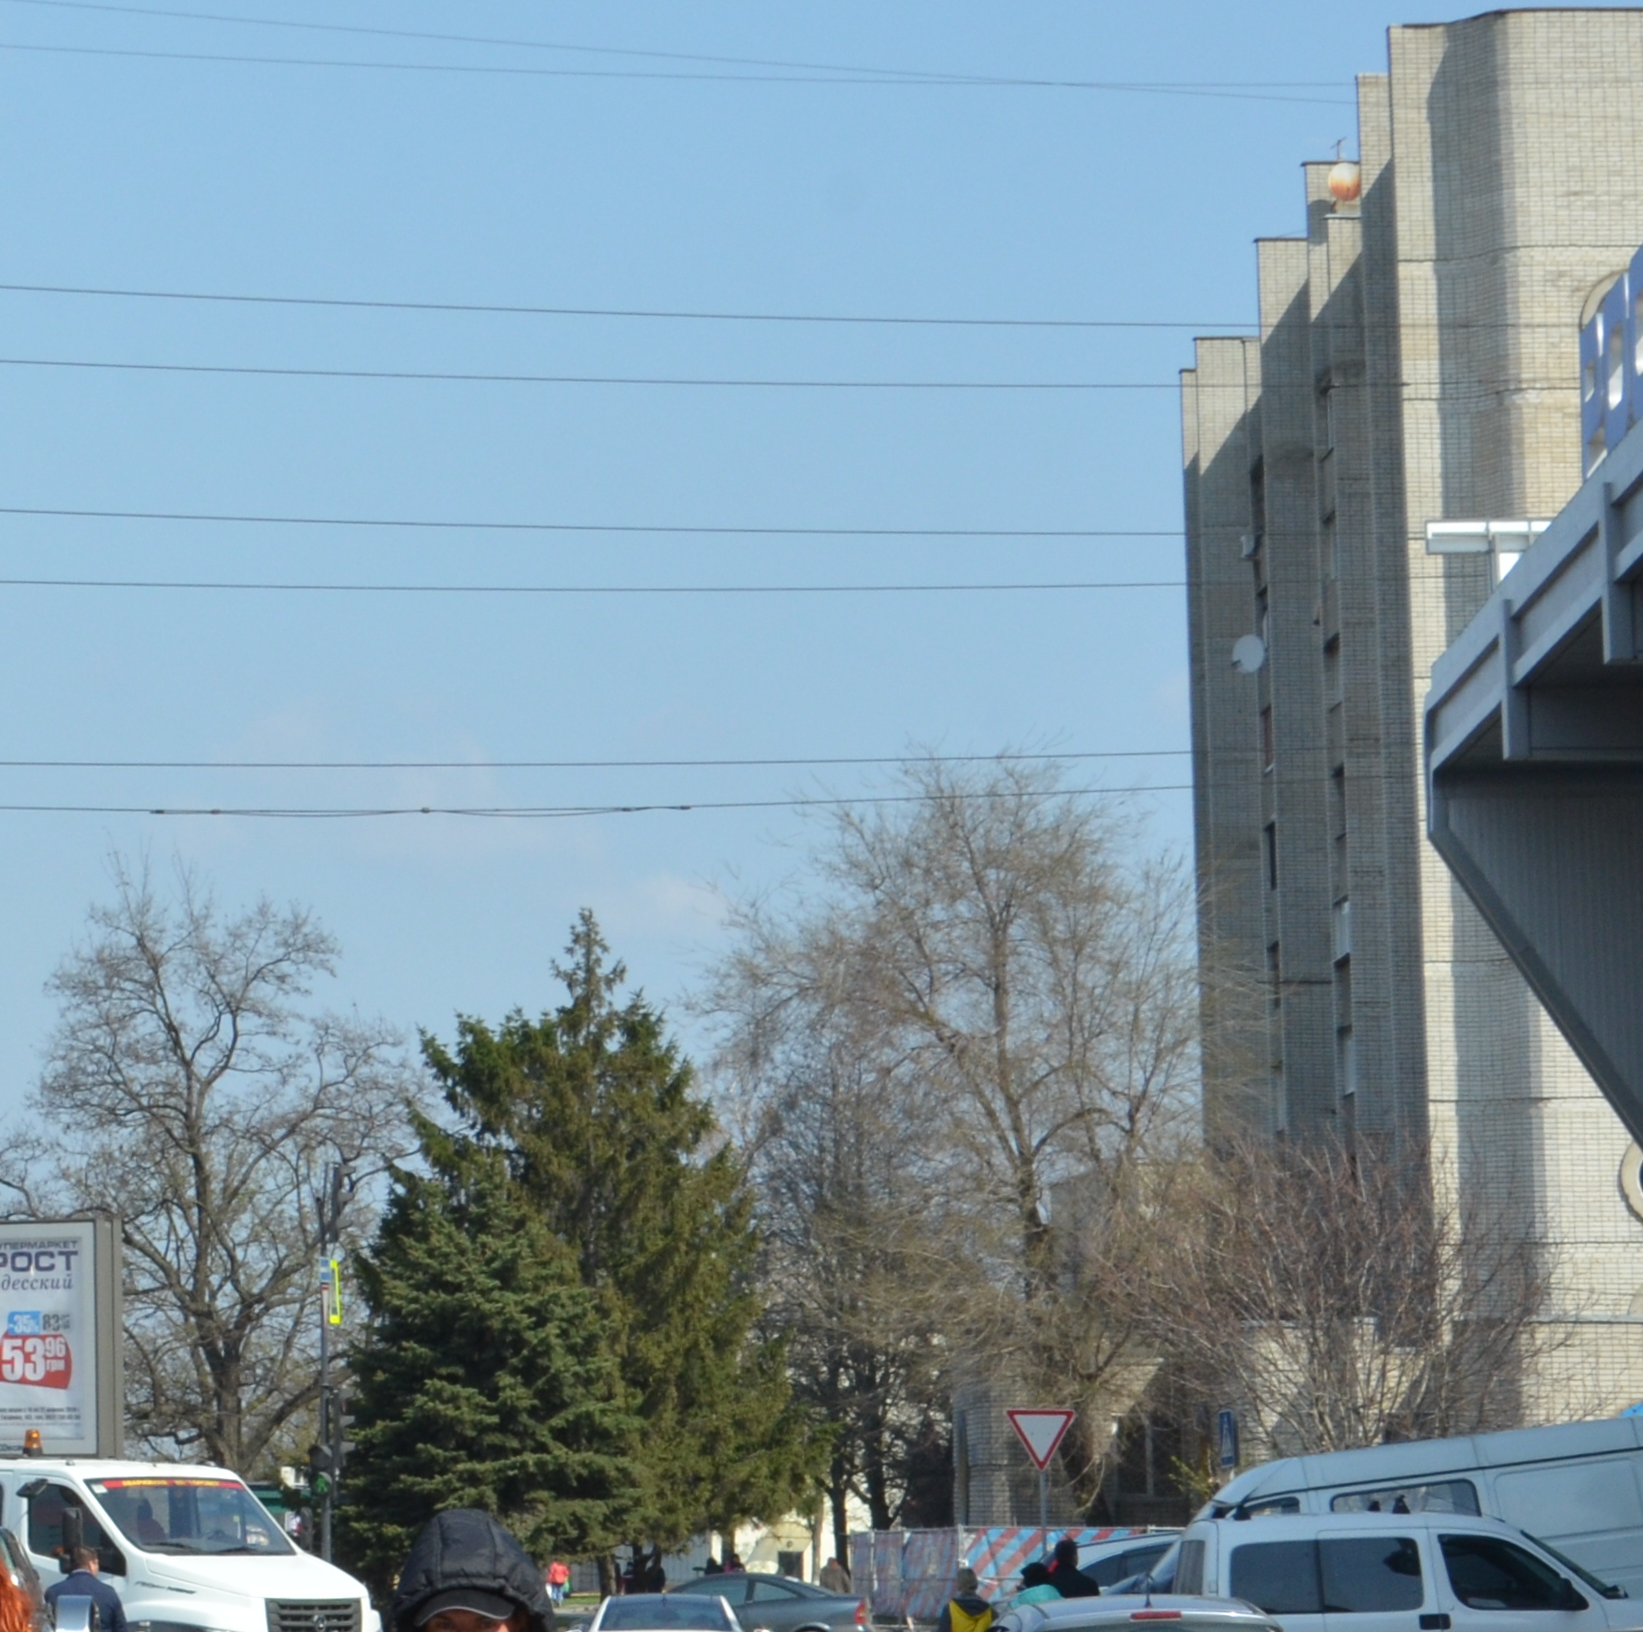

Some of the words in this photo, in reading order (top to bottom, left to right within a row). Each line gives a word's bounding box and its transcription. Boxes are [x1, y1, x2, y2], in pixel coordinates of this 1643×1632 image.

[9, 1314, 42, 1334] -35%
[45, 1336, 66, 1358] 96
[1, 1337, 46, 1381] 53
